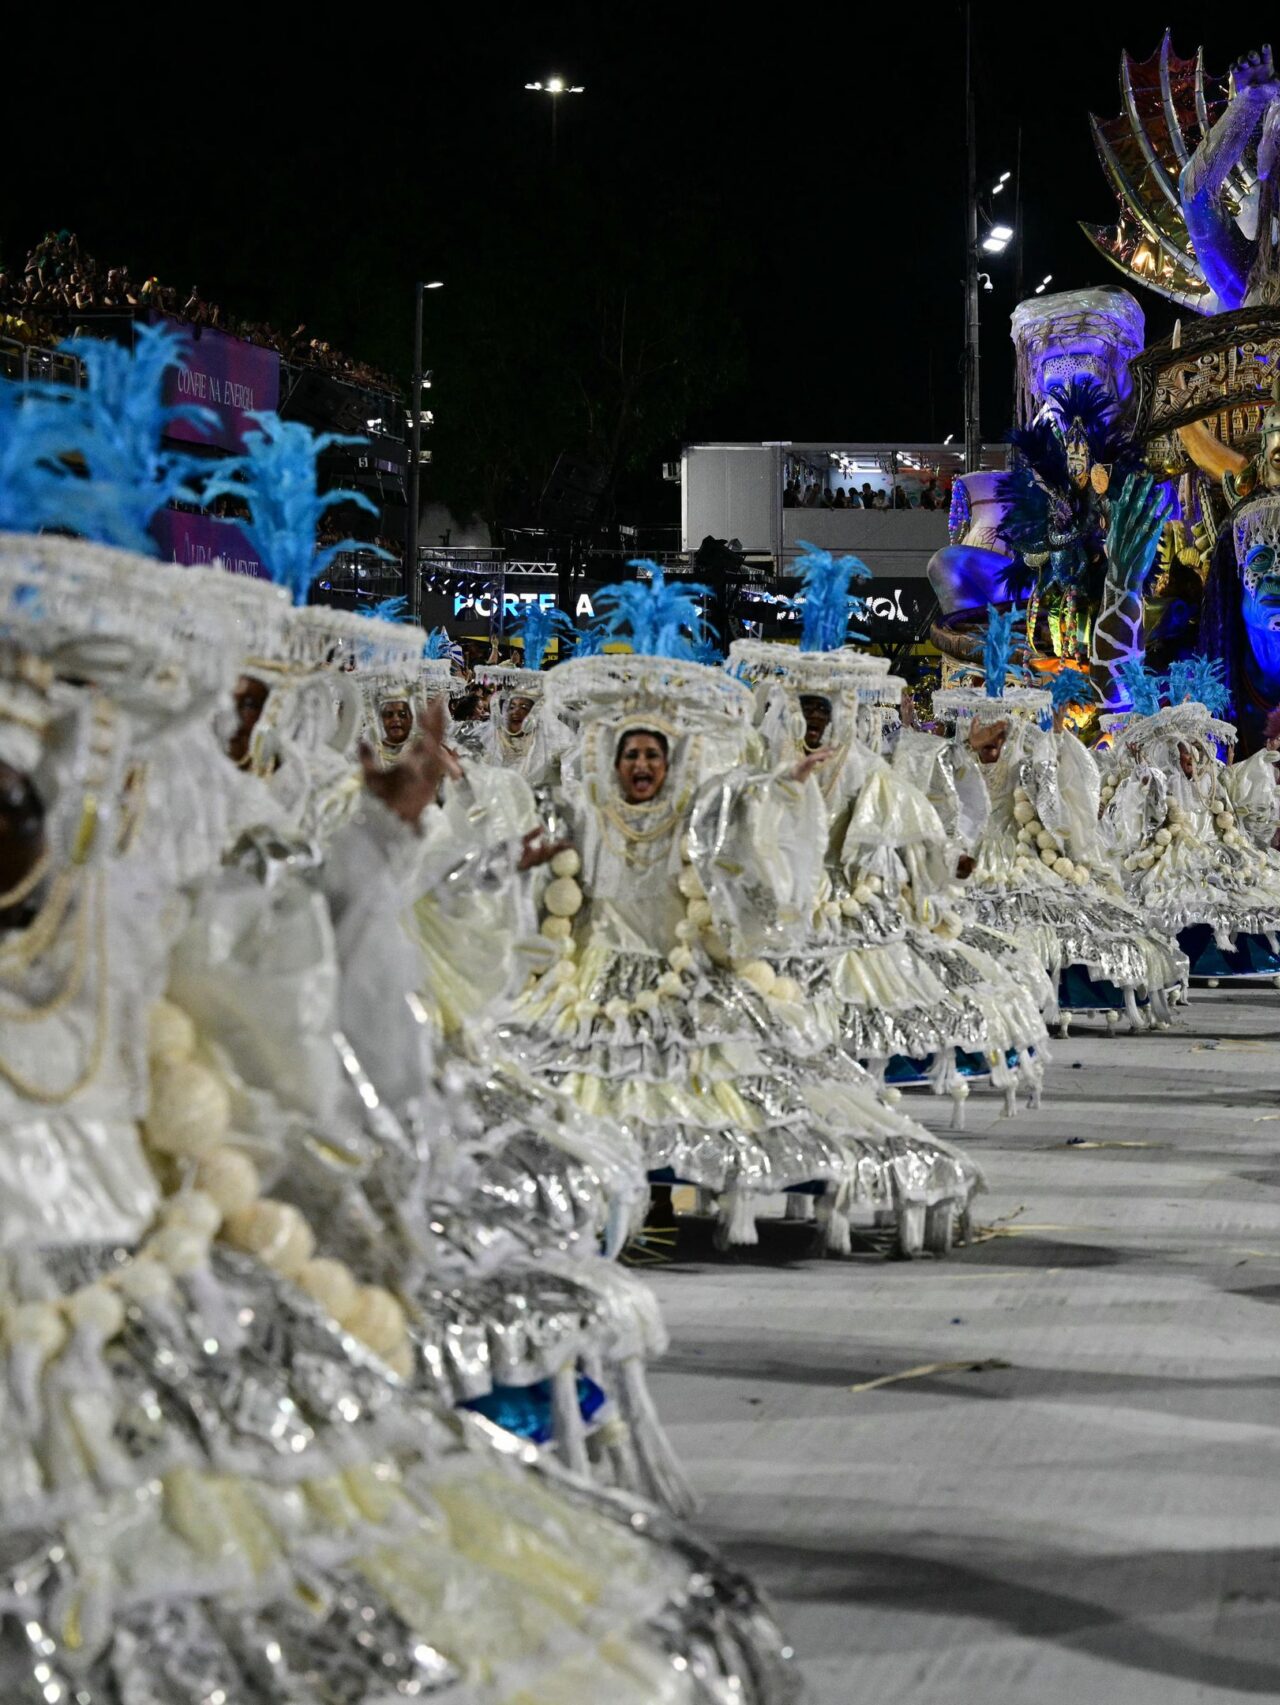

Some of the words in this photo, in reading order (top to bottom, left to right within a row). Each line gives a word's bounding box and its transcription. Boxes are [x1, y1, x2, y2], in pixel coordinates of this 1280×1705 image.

[177, 368, 207, 399] CONFIE
[209, 375, 221, 403] NA
[224, 380, 255, 412] ENERGIA
